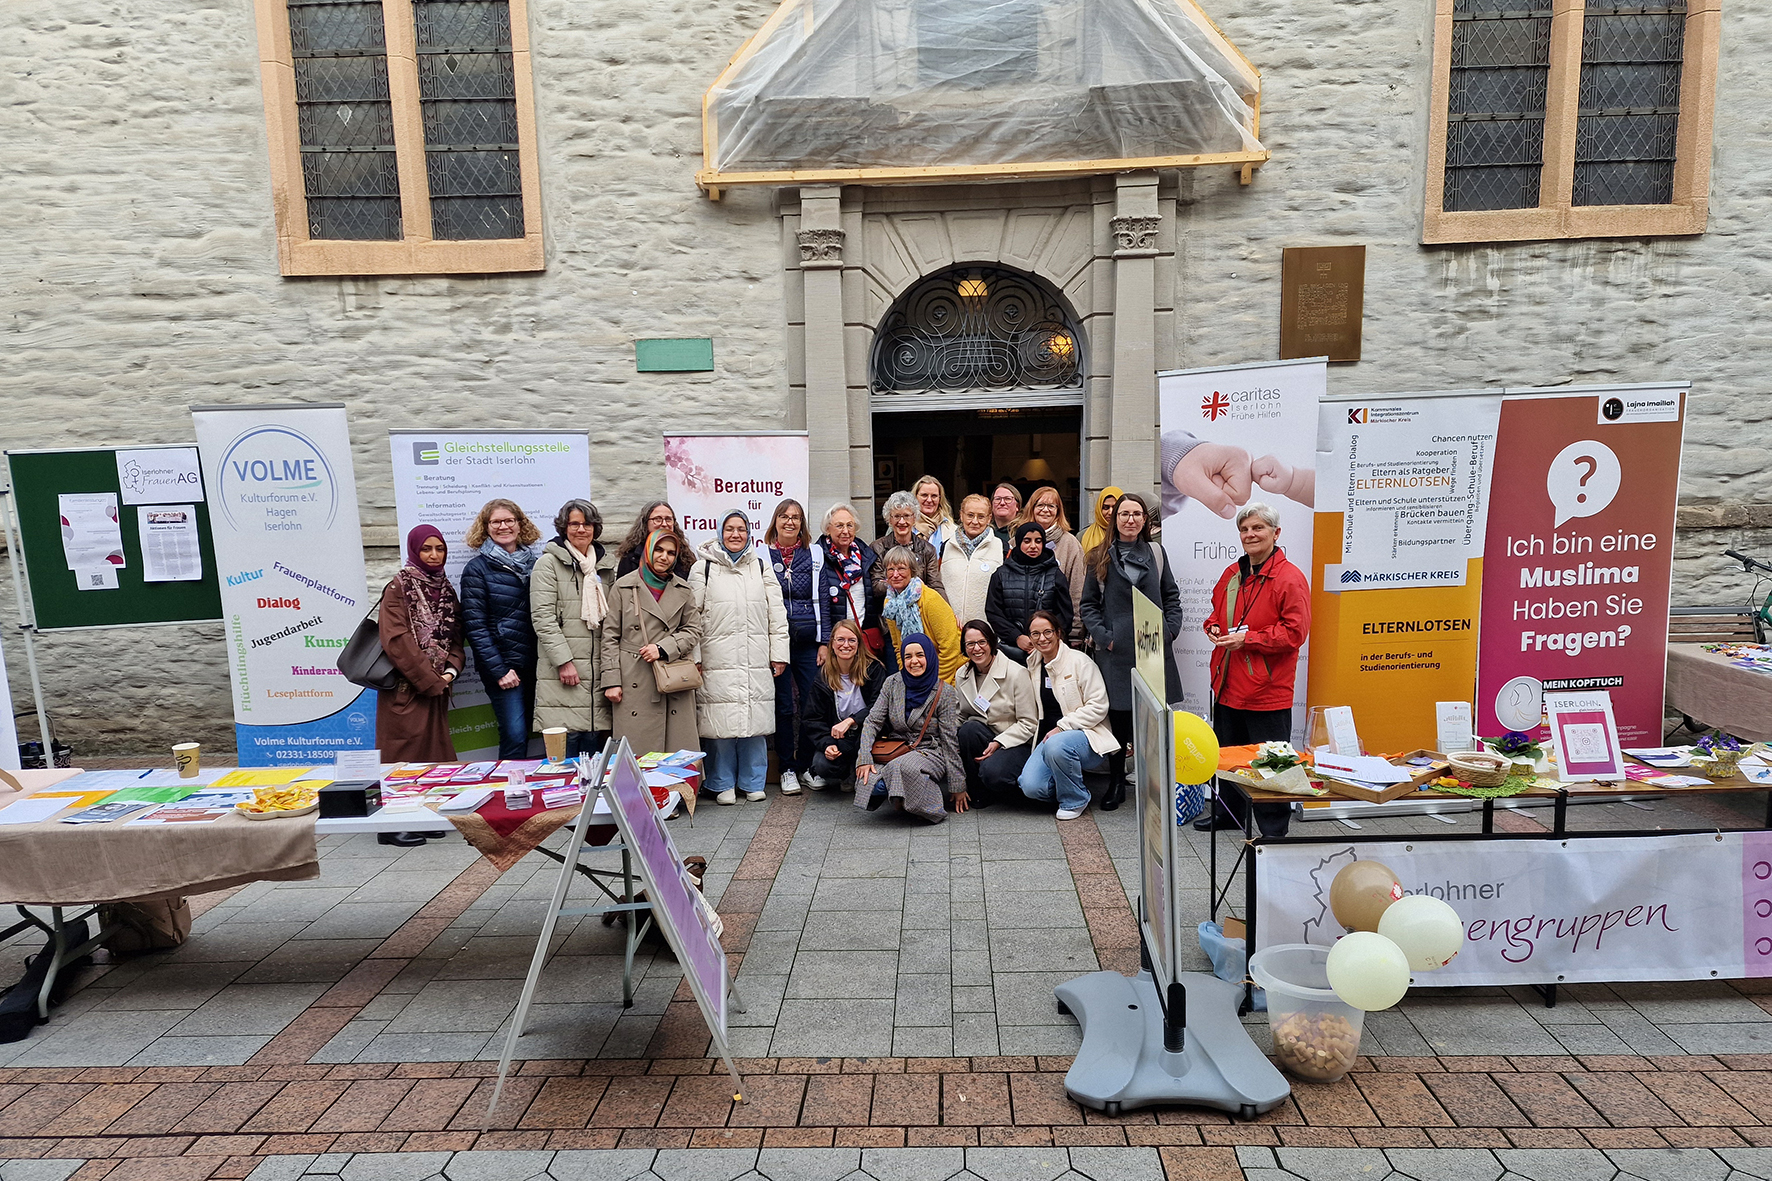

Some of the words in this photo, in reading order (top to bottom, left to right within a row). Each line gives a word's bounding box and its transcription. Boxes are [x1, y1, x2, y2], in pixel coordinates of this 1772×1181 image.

[1231, 387, 1281, 403] caritas
[1231, 402, 1281, 412] Iserlohn
[1626, 401, 1646, 409] Lajna
[1231, 411, 1255, 420] Frühe
[1257, 410, 1281, 419] Hilfen
[1348, 408, 1368, 424] KI
[1431, 435, 1466, 443] Chancen
[444, 442, 570, 455] Gleichstellungsstelle
[1349, 434, 1359, 459] Dialog
[1416, 449, 1457, 457] Kooperation
[446, 456, 462, 465] der
[466, 456, 493, 465] Stadt
[496, 455, 536, 465] Iserlohn
[1349, 461, 1356, 471] im
[232, 459, 317, 481] VOLME
[1372, 469, 1396, 477] Eltern
[1412, 466, 1450, 476] Ratgeber
[714, 478, 784, 496] Beratung
[1356, 476, 1450, 489] ELTERNLOTSEN
[1449, 477, 1457, 494] Wege
[240, 492, 299, 503] Kulturforum
[301, 492, 318, 502] e.V.
[1462, 441, 1478, 546] Übergang-Schule-Beruf
[748, 500, 762, 510] für
[1355, 498, 1377, 506] Eltern
[1393, 496, 1417, 504] Schule
[1418, 495, 1466, 503] unterstützen
[266, 507, 297, 519] Hagen
[1400, 509, 1436, 518] Brücken
[1437, 508, 1465, 517] bauen
[264, 521, 302, 531] Iserlohn
[683, 515, 717, 530] Frau
[749, 520, 760, 530] nd
[1398, 538, 1456, 547] Bildungspartner
[1506, 534, 1545, 557] Ich
[1552, 531, 1593, 554] bin
[1600, 529, 1657, 552] eine
[1194, 541, 1237, 560] Frühe
[226, 568, 263, 587] Kultur
[1364, 572, 1427, 582] MÄRKISCHER
[1430, 570, 1459, 579] KREIS
[1519, 561, 1640, 588] Muslima
[273, 561, 356, 607] Frauenplattform
[1194, 577, 1204, 585] Auf
[256, 597, 301, 610] Dialog
[1513, 597, 1598, 621] Haben
[1605, 593, 1643, 616] Sie
[251, 615, 323, 649] Jugendarbeit
[1362, 618, 1471, 634] ELTERNLOTSEN
[1521, 624, 1632, 657] Fragen?
[1370, 653, 1383, 661] der
[1385, 651, 1415, 660] Berufs-
[232, 614, 252, 712] Flüchtlingshilfe
[1360, 661, 1441, 672] Studienorientierung
[1543, 680, 1568, 689] MEIN
[1569, 677, 1623, 688] KOPFTUCH
[266, 688, 334, 700] Leseplattform
[253, 737, 286, 746] Volme
[287, 737, 344, 746] Kulturforum
[346, 737, 363, 746] e.V.
[276, 750, 337, 759] 02331-18509
[1183, 737, 1206, 764] caritas
[1463, 903, 1679, 963] engruppen
